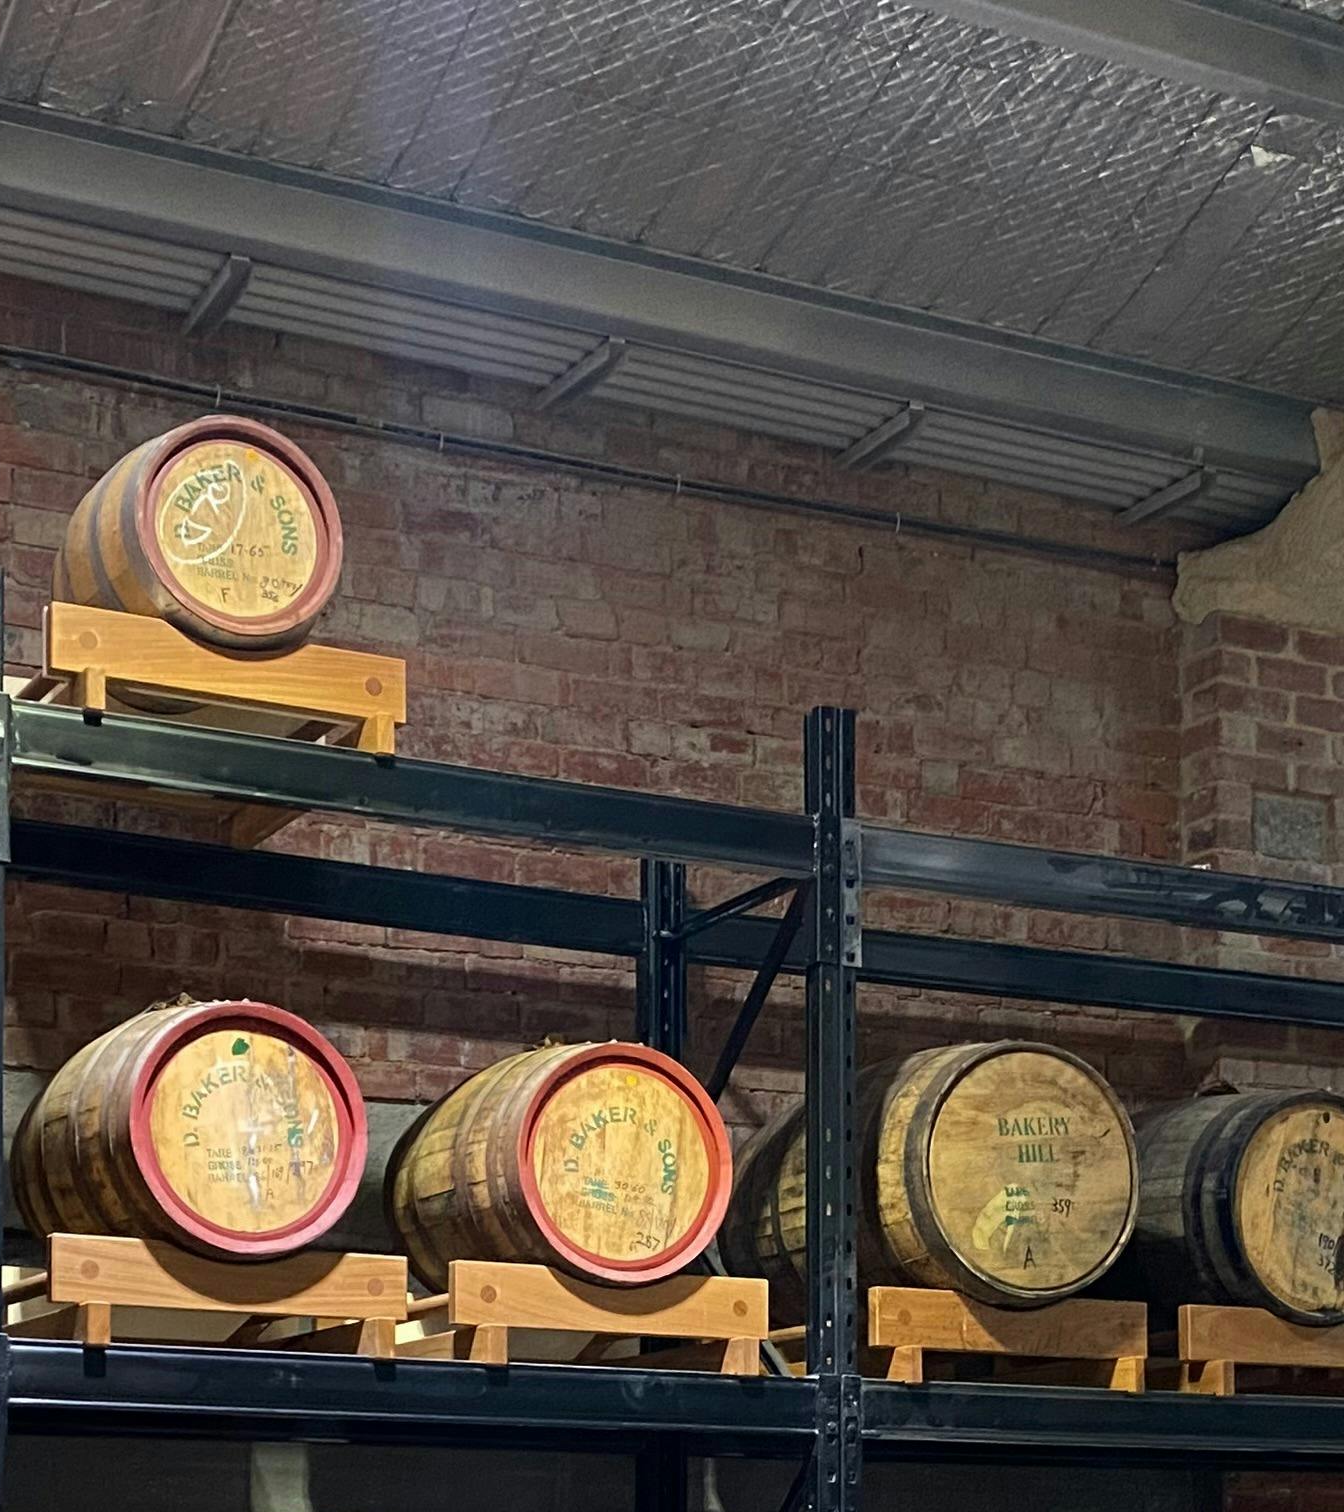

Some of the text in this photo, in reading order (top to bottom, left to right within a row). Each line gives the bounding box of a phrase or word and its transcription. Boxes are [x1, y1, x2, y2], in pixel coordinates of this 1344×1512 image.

[270, 495, 300, 557] SONS
[182, 1066, 248, 1120] BAKER
[997, 1117, 1071, 1137] BAKERY
[569, 1106, 637, 1150] BAKER
[658, 1139, 677, 1196] SONS
[1018, 1144, 1060, 1163] HILL
[1051, 1199, 1072, 1218] 359
[1023, 1245, 1037, 1270] A
